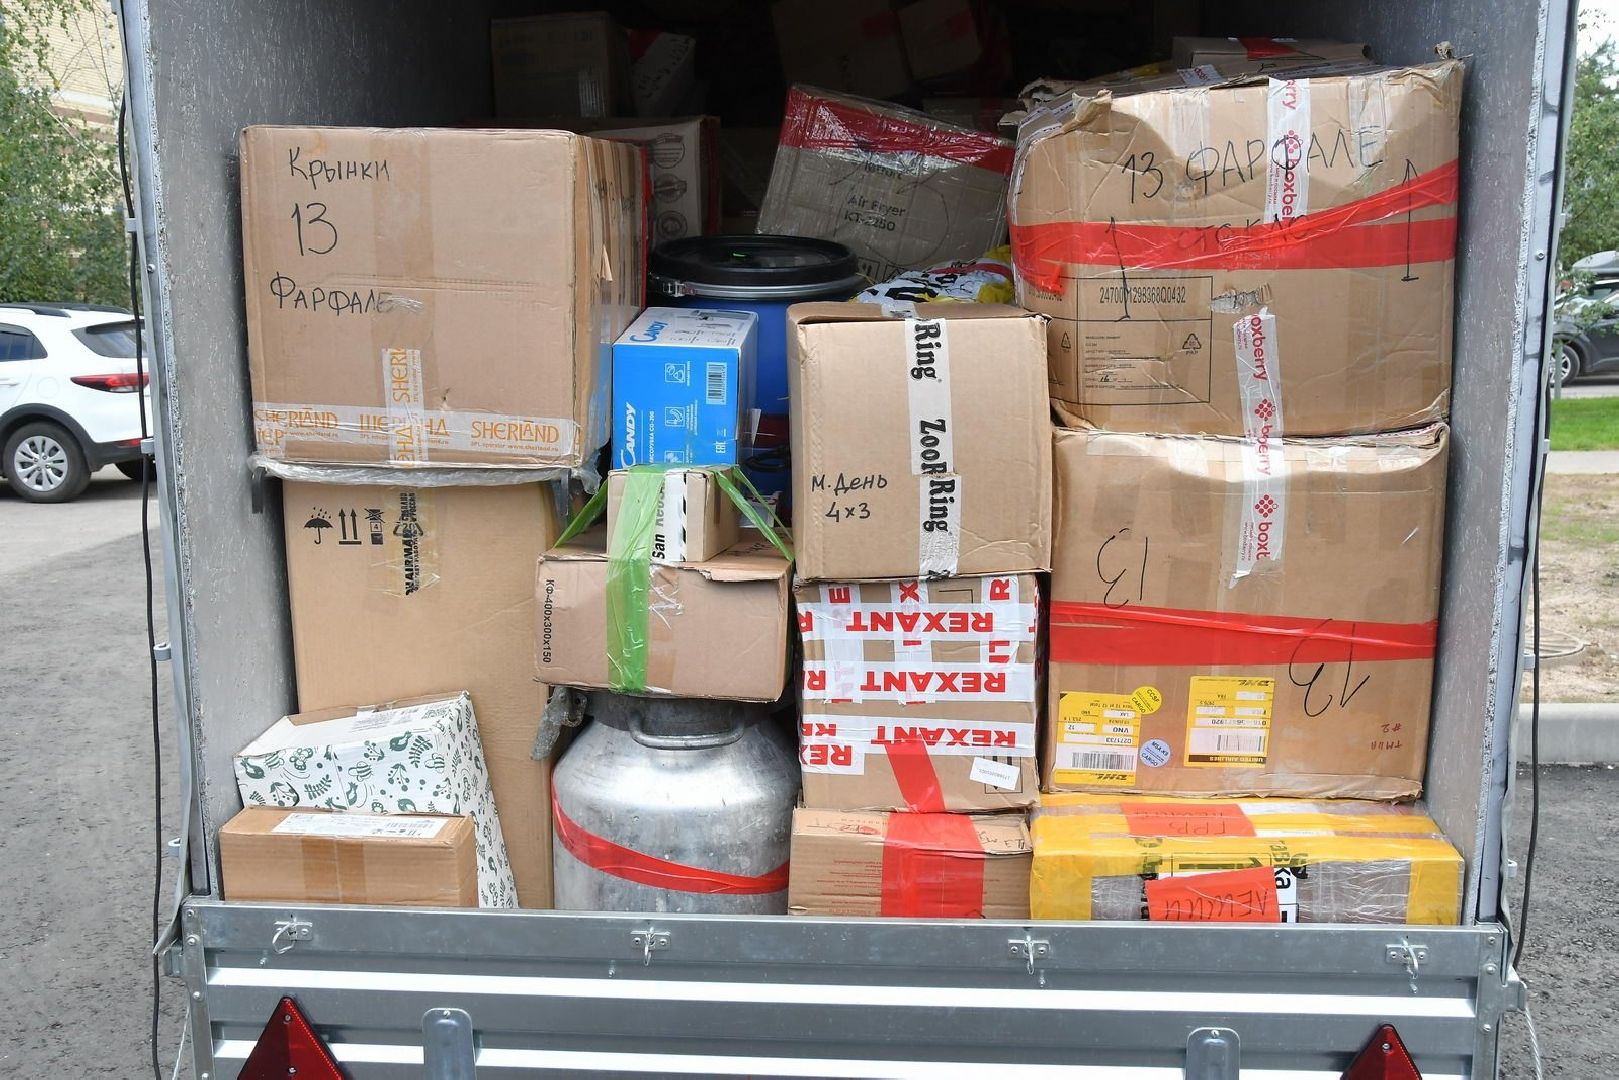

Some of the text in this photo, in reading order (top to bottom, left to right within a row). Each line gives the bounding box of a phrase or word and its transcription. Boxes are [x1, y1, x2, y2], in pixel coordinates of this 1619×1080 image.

[1122, 152, 1163, 203] 13
[291, 202, 338, 256] 13
[1250, 315, 1268, 381] oxberry
[651, 533, 666, 560] San
[846, 611, 994, 633] REXANT
[860, 671, 1006, 693] REXANT
[870, 725, 1017, 748] REXANT
[1112, 726, 1130, 734] VNO
